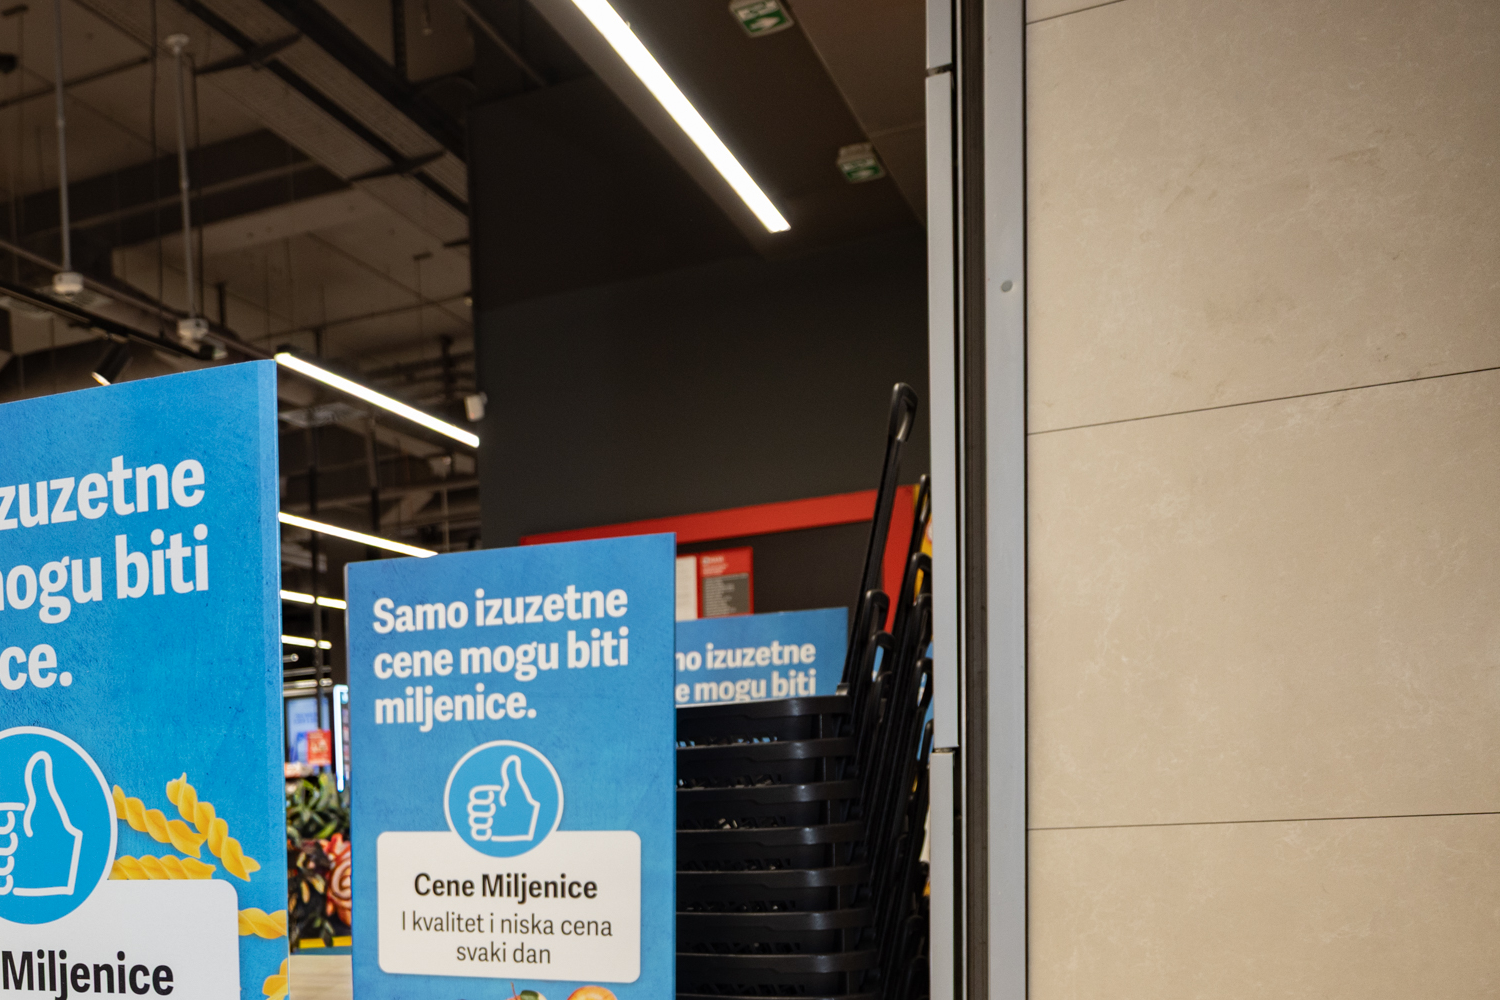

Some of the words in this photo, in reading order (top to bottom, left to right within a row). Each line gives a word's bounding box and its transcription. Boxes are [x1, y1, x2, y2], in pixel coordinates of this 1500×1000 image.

[114, 523, 210, 600] biti
[372, 597, 469, 634] Samo
[475, 584, 628, 627] izuzetne
[373, 648, 454, 680] cene
[460, 641, 559, 682] mogu
[567, 626, 629, 669] biti
[705, 641, 817, 670] izuzetne
[694, 677, 767, 702] mogu
[770, 668, 817, 697] biti
[374, 682, 537, 733] miljenice.
[414, 872, 476, 897] Cene
[481, 872, 598, 905] Miljenice
[402, 910, 406, 931] I
[412, 910, 485, 934] kvalitet
[489, 912, 494, 934] i
[500, 913, 555, 936] niska
[560, 919, 613, 937] cena
[456, 941, 507, 963] svaki
[512, 941, 551, 964] dan
